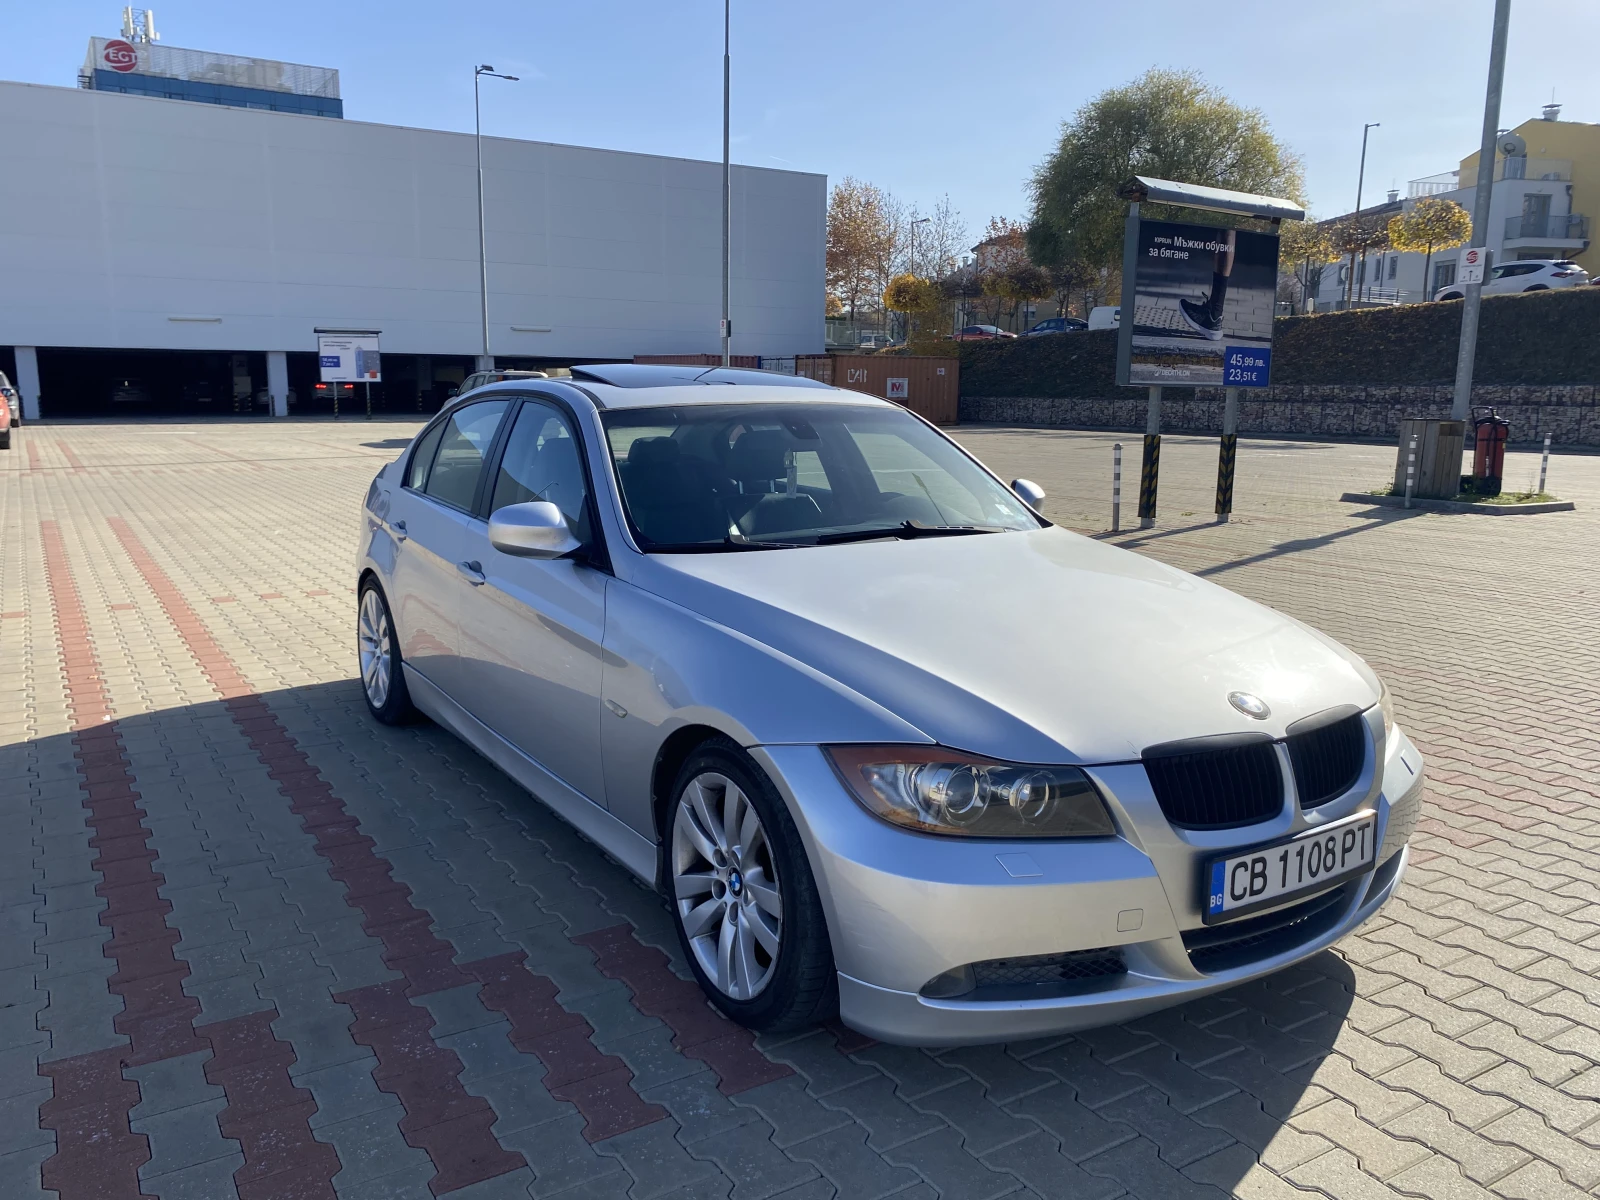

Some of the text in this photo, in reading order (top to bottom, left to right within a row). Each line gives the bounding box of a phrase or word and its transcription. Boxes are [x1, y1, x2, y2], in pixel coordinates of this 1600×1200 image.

[1173, 236, 1204, 249] Мъжки
[1205, 241, 1235, 253] обувки
[1148, 247, 1189, 259] за бягане
[1230, 354, 1254, 367] 45,99
[1229, 368, 1257, 382] 23,51 €
[1230, 822, 1370, 901] CB 1108 PT
[1210, 893, 1223, 907] BG
